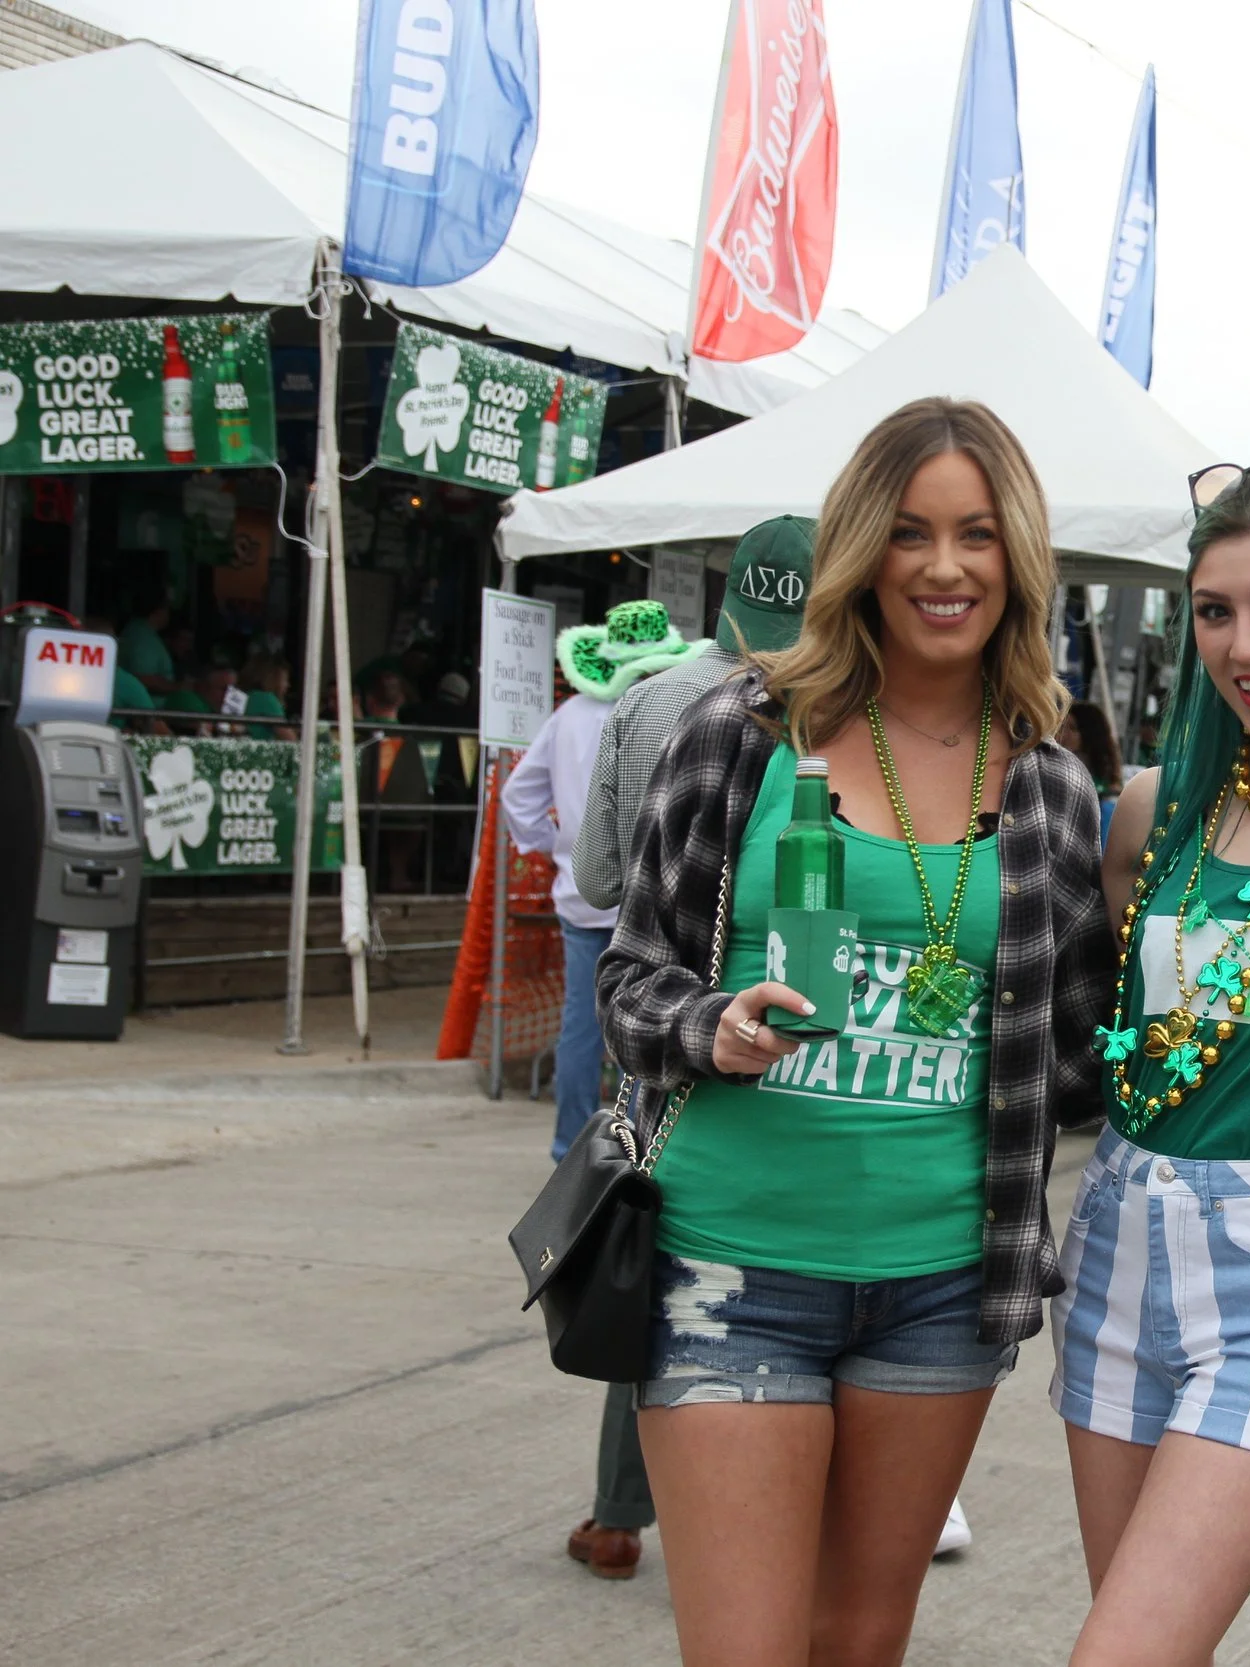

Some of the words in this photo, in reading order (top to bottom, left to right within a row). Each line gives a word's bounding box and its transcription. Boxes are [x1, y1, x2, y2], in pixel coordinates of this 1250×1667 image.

[381, 0, 453, 176] BUD
[1104, 190, 1154, 344] LIGHT
[33, 353, 121, 380] GOOD
[36, 382, 124, 409] LUCK.
[477, 378, 529, 412] GOOD
[39, 408, 134, 436] GREAT
[472, 401, 520, 436] LUCK.
[41, 435, 145, 463] LAGER.
[468, 428, 523, 462] GREAT
[464, 453, 524, 488] LAGER.
[739, 562, 804, 606] ΔΣΦ
[494, 599, 532, 629] Sausage
[533, 611, 546, 627] on
[512, 626, 535, 648] Stick
[37, 640, 105, 668] ATM
[494, 659, 517, 680] Foot
[517, 663, 544, 691] Long
[220, 768, 275, 792] GOOD
[220, 792, 273, 816] LUCK.
[219, 816, 279, 841] GREAT
[217, 841, 282, 866] LAGER.
[767, 1038, 963, 1105] MATTER
